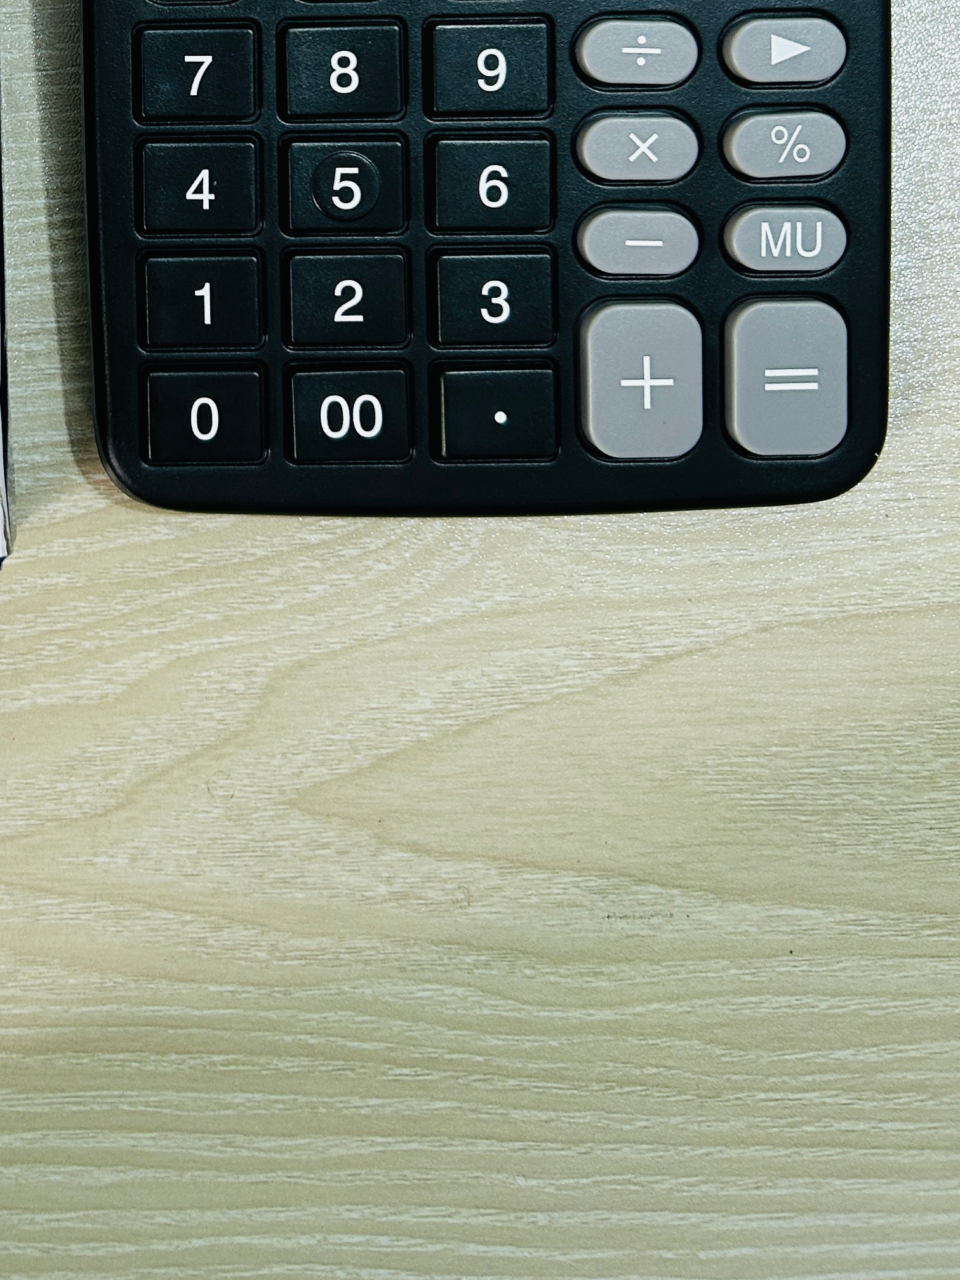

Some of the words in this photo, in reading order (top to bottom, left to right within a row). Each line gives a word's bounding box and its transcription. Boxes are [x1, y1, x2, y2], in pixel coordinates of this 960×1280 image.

[184, 55, 213, 96] 7
[329, 50, 360, 94] 8
[476, 48, 507, 92] 9
[770, 124, 811, 164] %
[185, 168, 216, 210] 4
[331, 167, 362, 210] 5
[478, 164, 509, 208] 6
[760, 221, 823, 258] MU
[194, 282, 212, 325] 1
[333, 279, 364, 323] 2
[480, 280, 511, 324] 3
[190, 397, 219, 441] 0
[320, 394, 383, 439] 00
